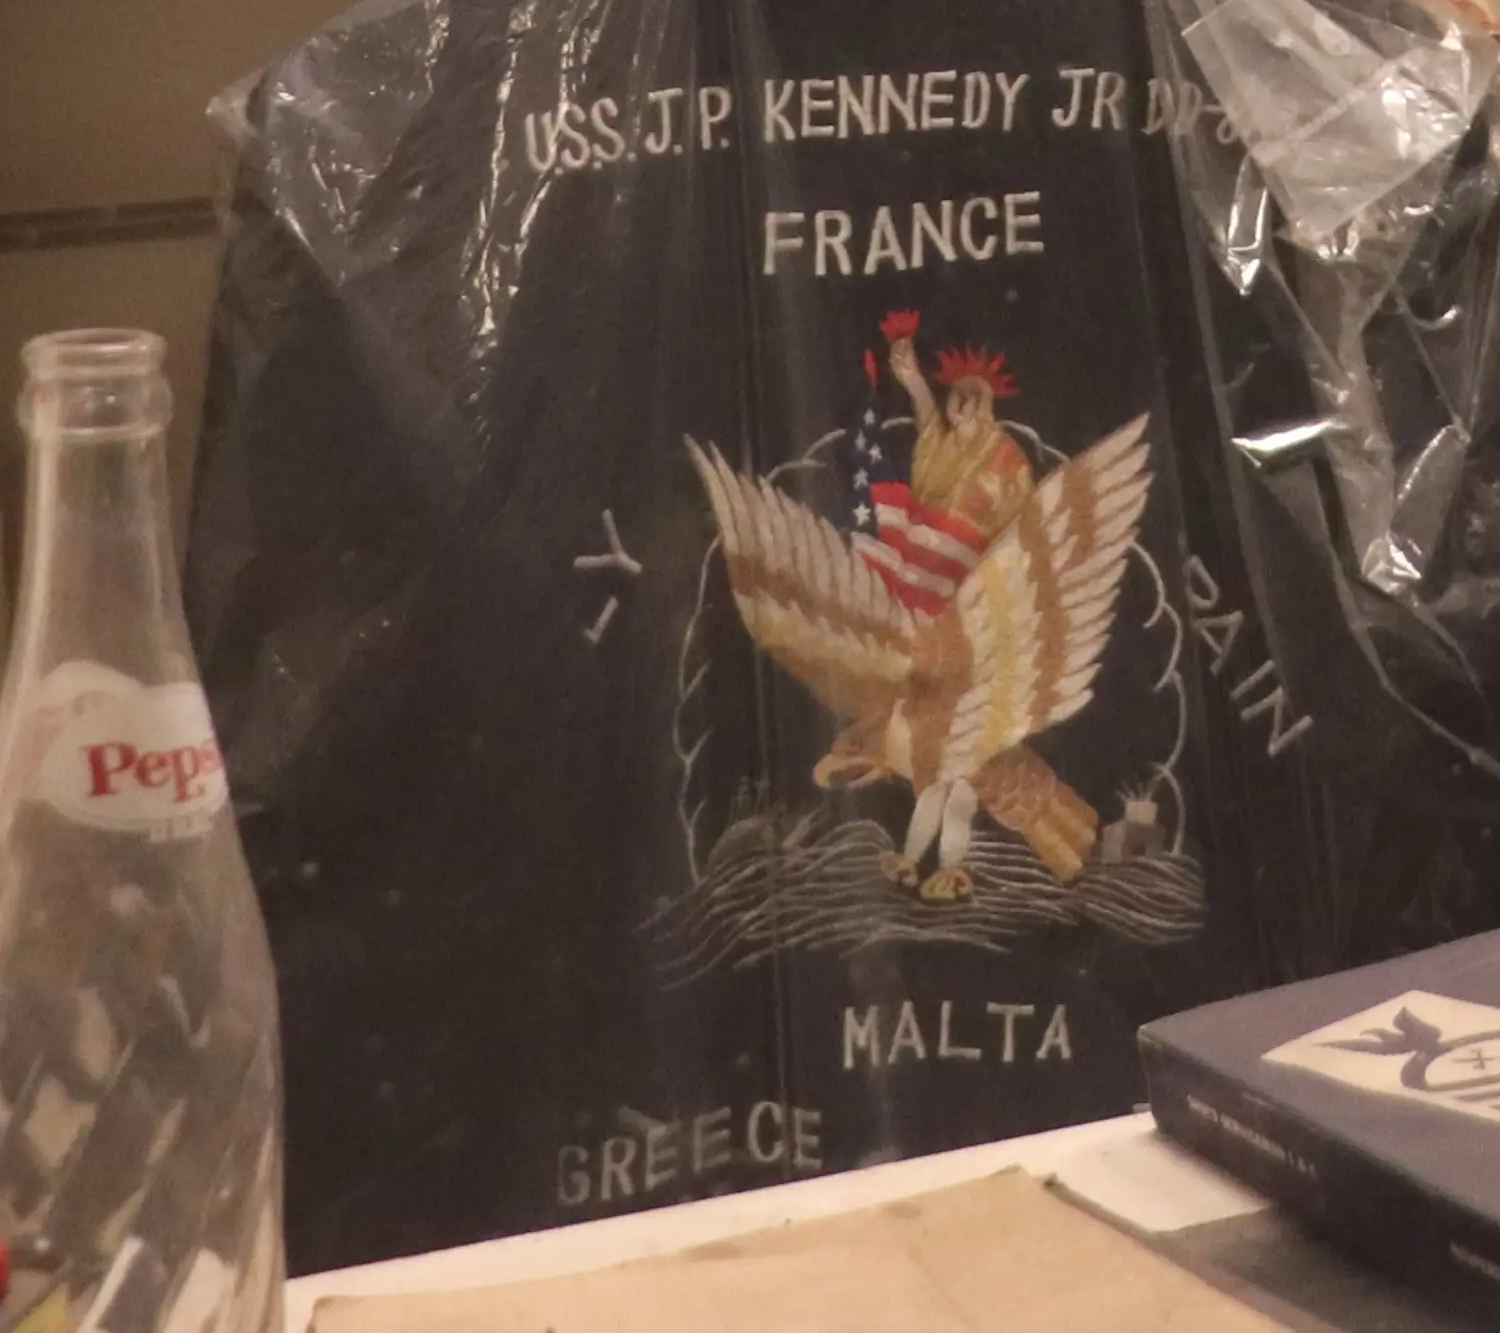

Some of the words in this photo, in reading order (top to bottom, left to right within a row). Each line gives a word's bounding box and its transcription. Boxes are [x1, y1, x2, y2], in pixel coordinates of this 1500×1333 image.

[763, 68, 1031, 143] KENNEDY
[1051, 67, 1127, 131] JR
[762, 190, 1045, 277] FRANCE
[80, 740, 224, 804] Peps
[842, 1002, 1074, 1070] MALTA
[555, 1100, 824, 1205] GREECE
